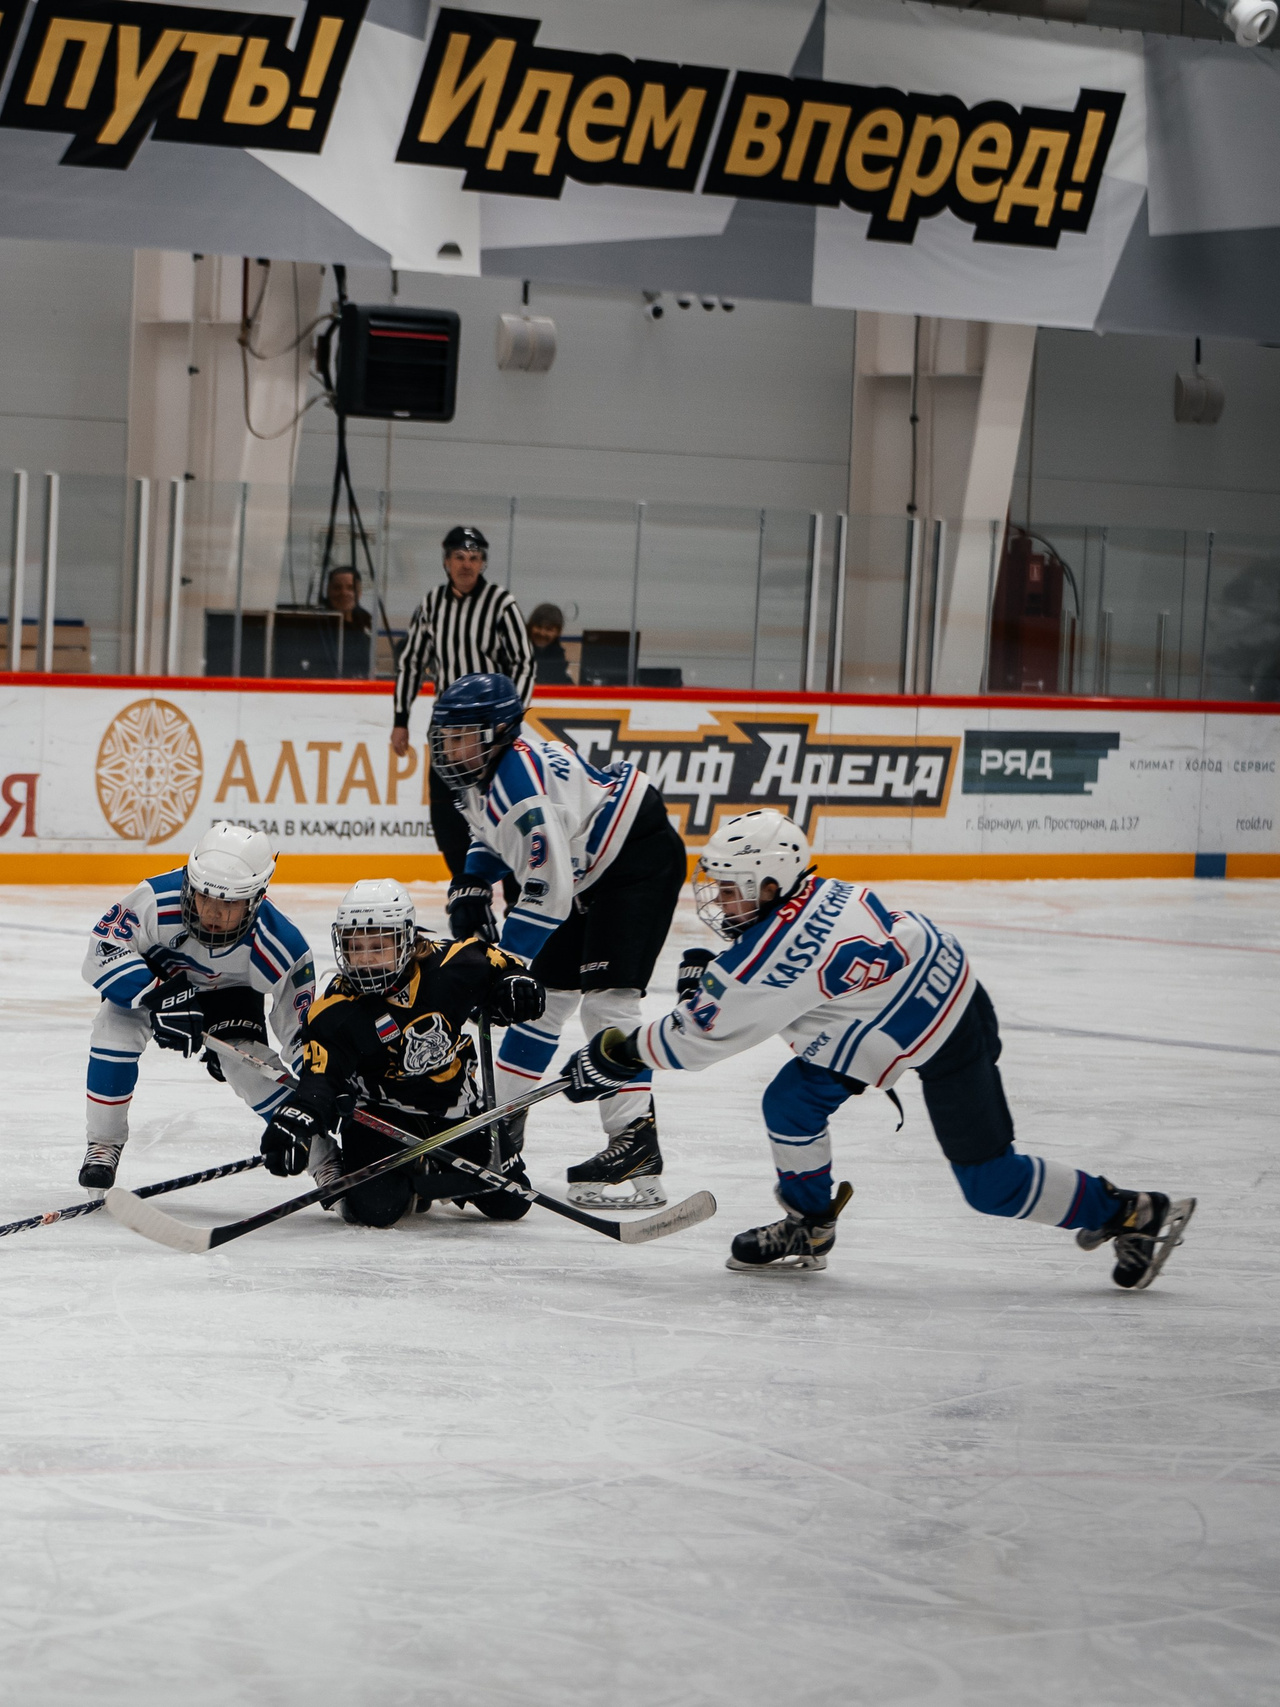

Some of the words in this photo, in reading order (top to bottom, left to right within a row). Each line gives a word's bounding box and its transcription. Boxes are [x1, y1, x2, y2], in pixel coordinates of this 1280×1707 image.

[24, 16, 344, 145] путь!
[418, 32, 707, 177] Идем
[724, 94, 1106, 228] вперед!
[214, 739, 431, 805] АЛТАР
[980, 749, 1053, 780] РЯД
[1129, 760, 1175, 772] КЛИМАТ
[1185, 759, 1222, 773] ХОЛОД
[1233, 761, 1276, 773] СЕРВИС
[285, 820, 295, 836] В
[301, 817, 375, 839] КАЖДОЙ
[977, 816, 1023, 832] Барнаул,
[450, 886, 492, 902] AUER
[92, 903, 141, 942] 25
[162, 987, 197, 1010] BAU
[394, 991, 410, 1006] 79
[207, 1018, 264, 1035] BAUER
[275, 1105, 315, 1127] UER
[500, 1152, 520, 1174] CM
[451, 1157, 540, 1203] CCM
